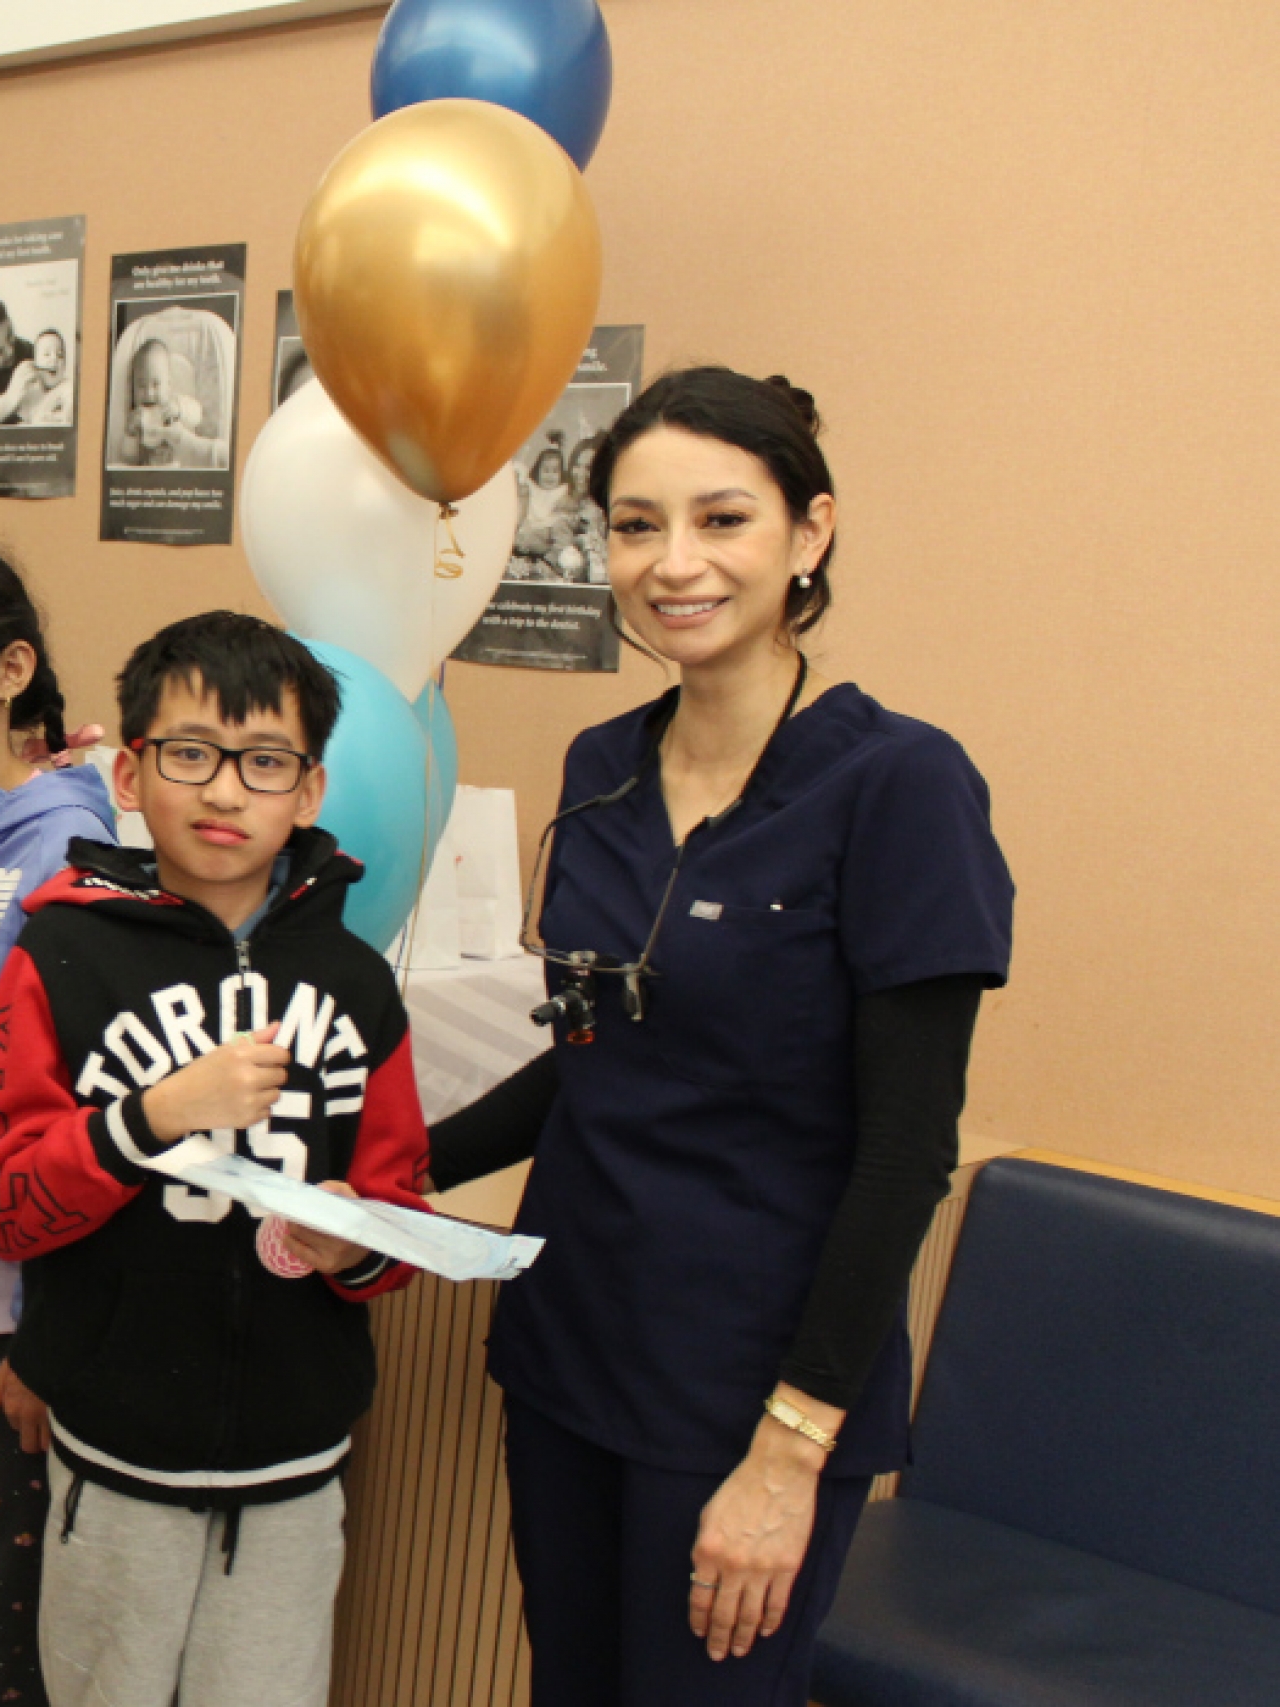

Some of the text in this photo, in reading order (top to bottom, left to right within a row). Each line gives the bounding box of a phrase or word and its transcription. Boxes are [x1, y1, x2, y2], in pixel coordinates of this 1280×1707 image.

[145, 276, 173, 290] healthy
[186, 277, 199, 290] my
[565, 604, 601, 620] birthday
[482, 614, 501, 625] with
[508, 616, 525, 630] trip
[535, 616, 549, 628] the
